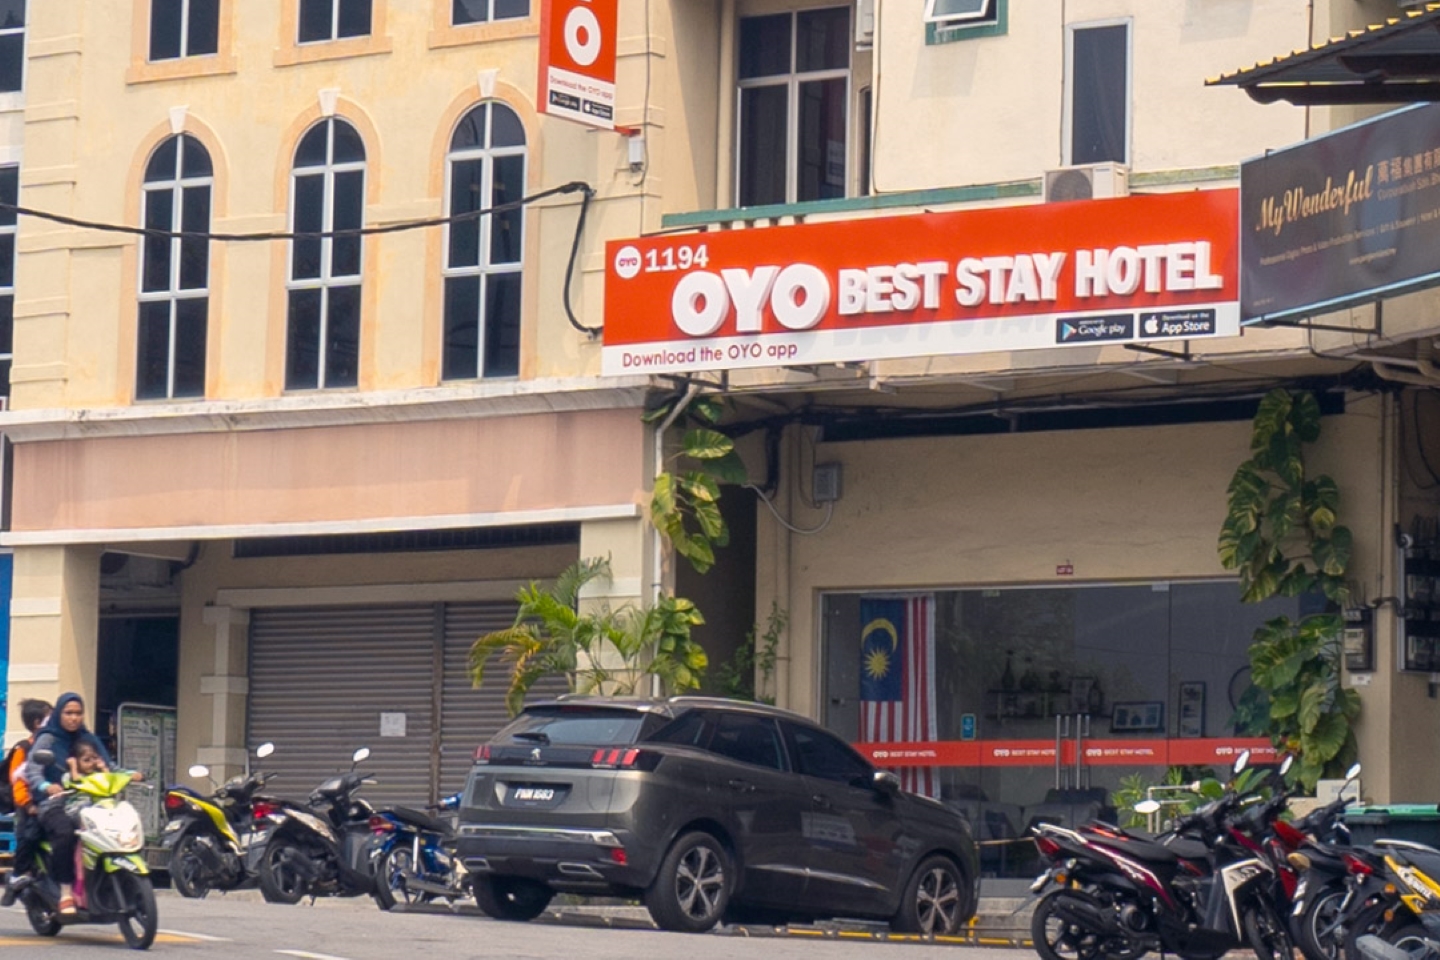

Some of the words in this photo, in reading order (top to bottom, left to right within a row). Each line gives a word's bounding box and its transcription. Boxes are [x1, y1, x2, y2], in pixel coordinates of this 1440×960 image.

[618, 256, 638, 268] OYO
[644, 244, 710, 273] 1194
[671, 262, 831, 337] OYO
[838, 261, 948, 316] BEST
[955, 252, 1067, 307] STAY
[1075, 241, 1223, 298] HOTEL
[1108, 323, 1126, 335] play
[1161, 322, 1183, 334] App
[1183, 320, 1210, 332] Store
[622, 347, 696, 368] Download
[699, 346, 723, 362] the
[727, 343, 763, 360] OYO
[767, 343, 799, 360] app
